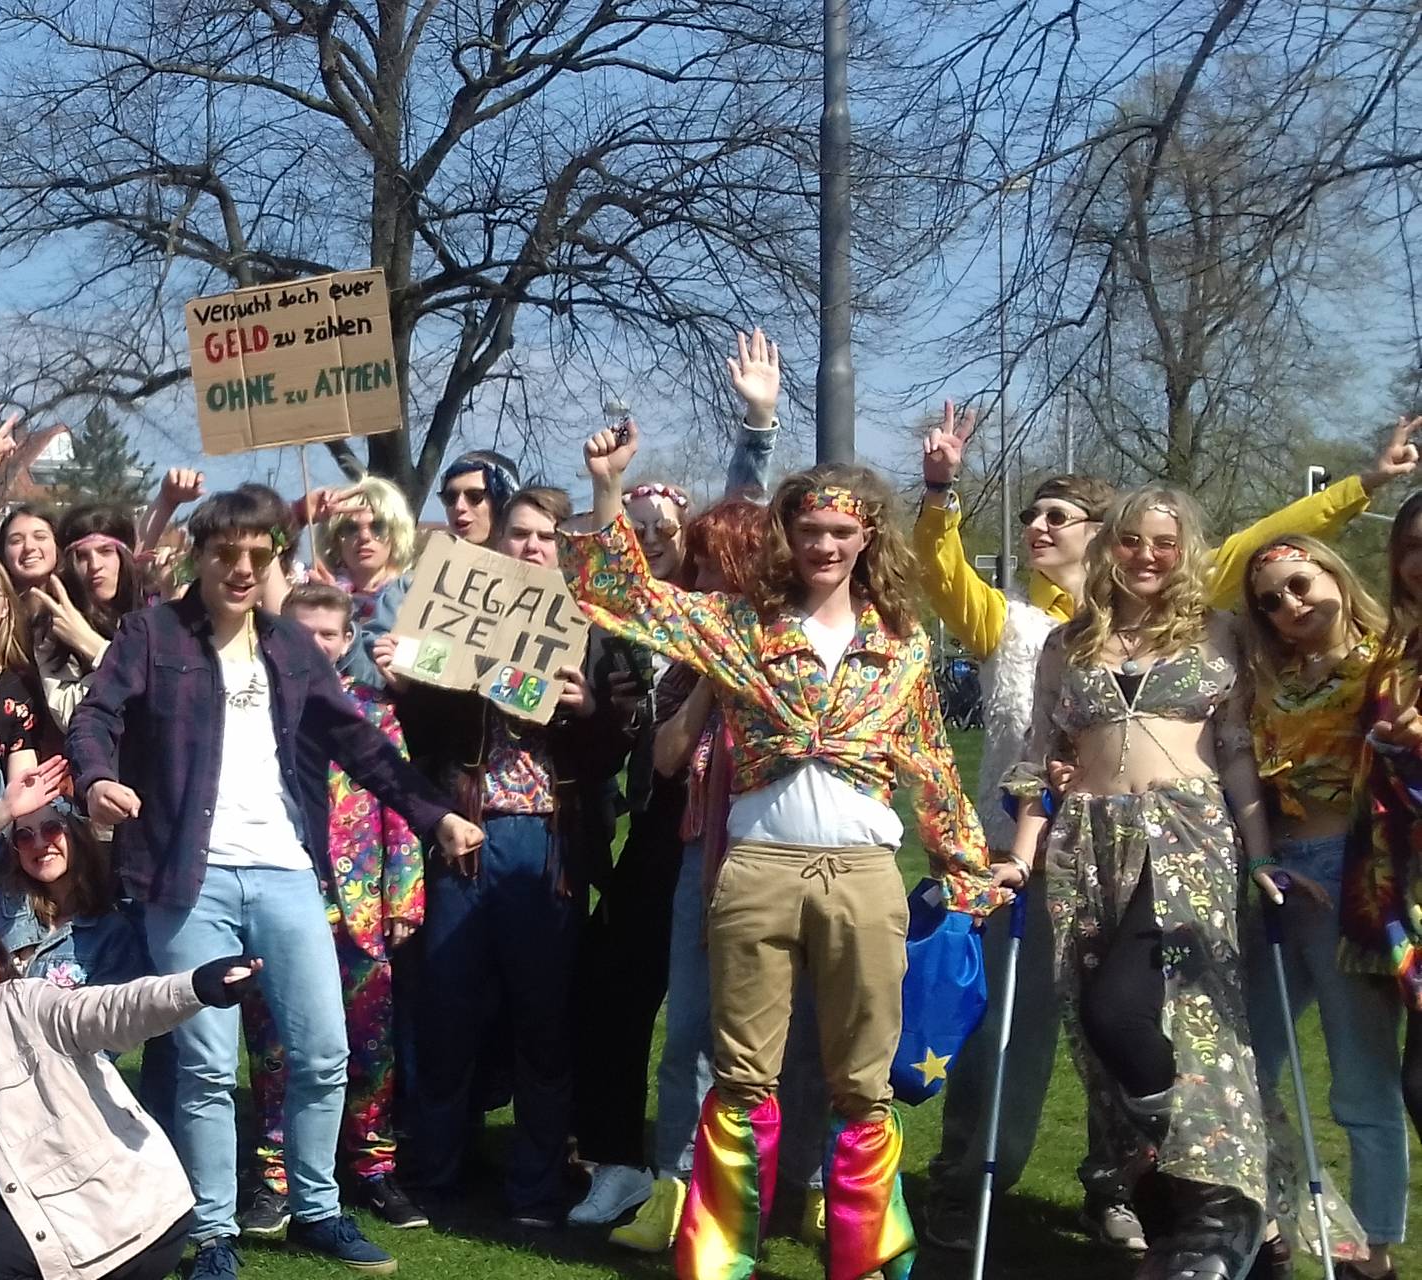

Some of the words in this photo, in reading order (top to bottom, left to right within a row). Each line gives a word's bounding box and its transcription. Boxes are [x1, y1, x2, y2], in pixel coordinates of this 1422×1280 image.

[278, 288, 318, 308] doch
[330, 279, 374, 299] euer
[205, 325, 269, 363] GELD
[274, 331, 296, 348] zu
[304, 316, 372, 344] zählen
[206, 373, 277, 412] OHNE
[283, 388, 308, 404] zu
[314, 359, 392, 398] ATMEN
[433, 560, 586, 633] LEGAL-
[419, 600, 497, 649] IZE
[511, 631, 569, 673] IT
